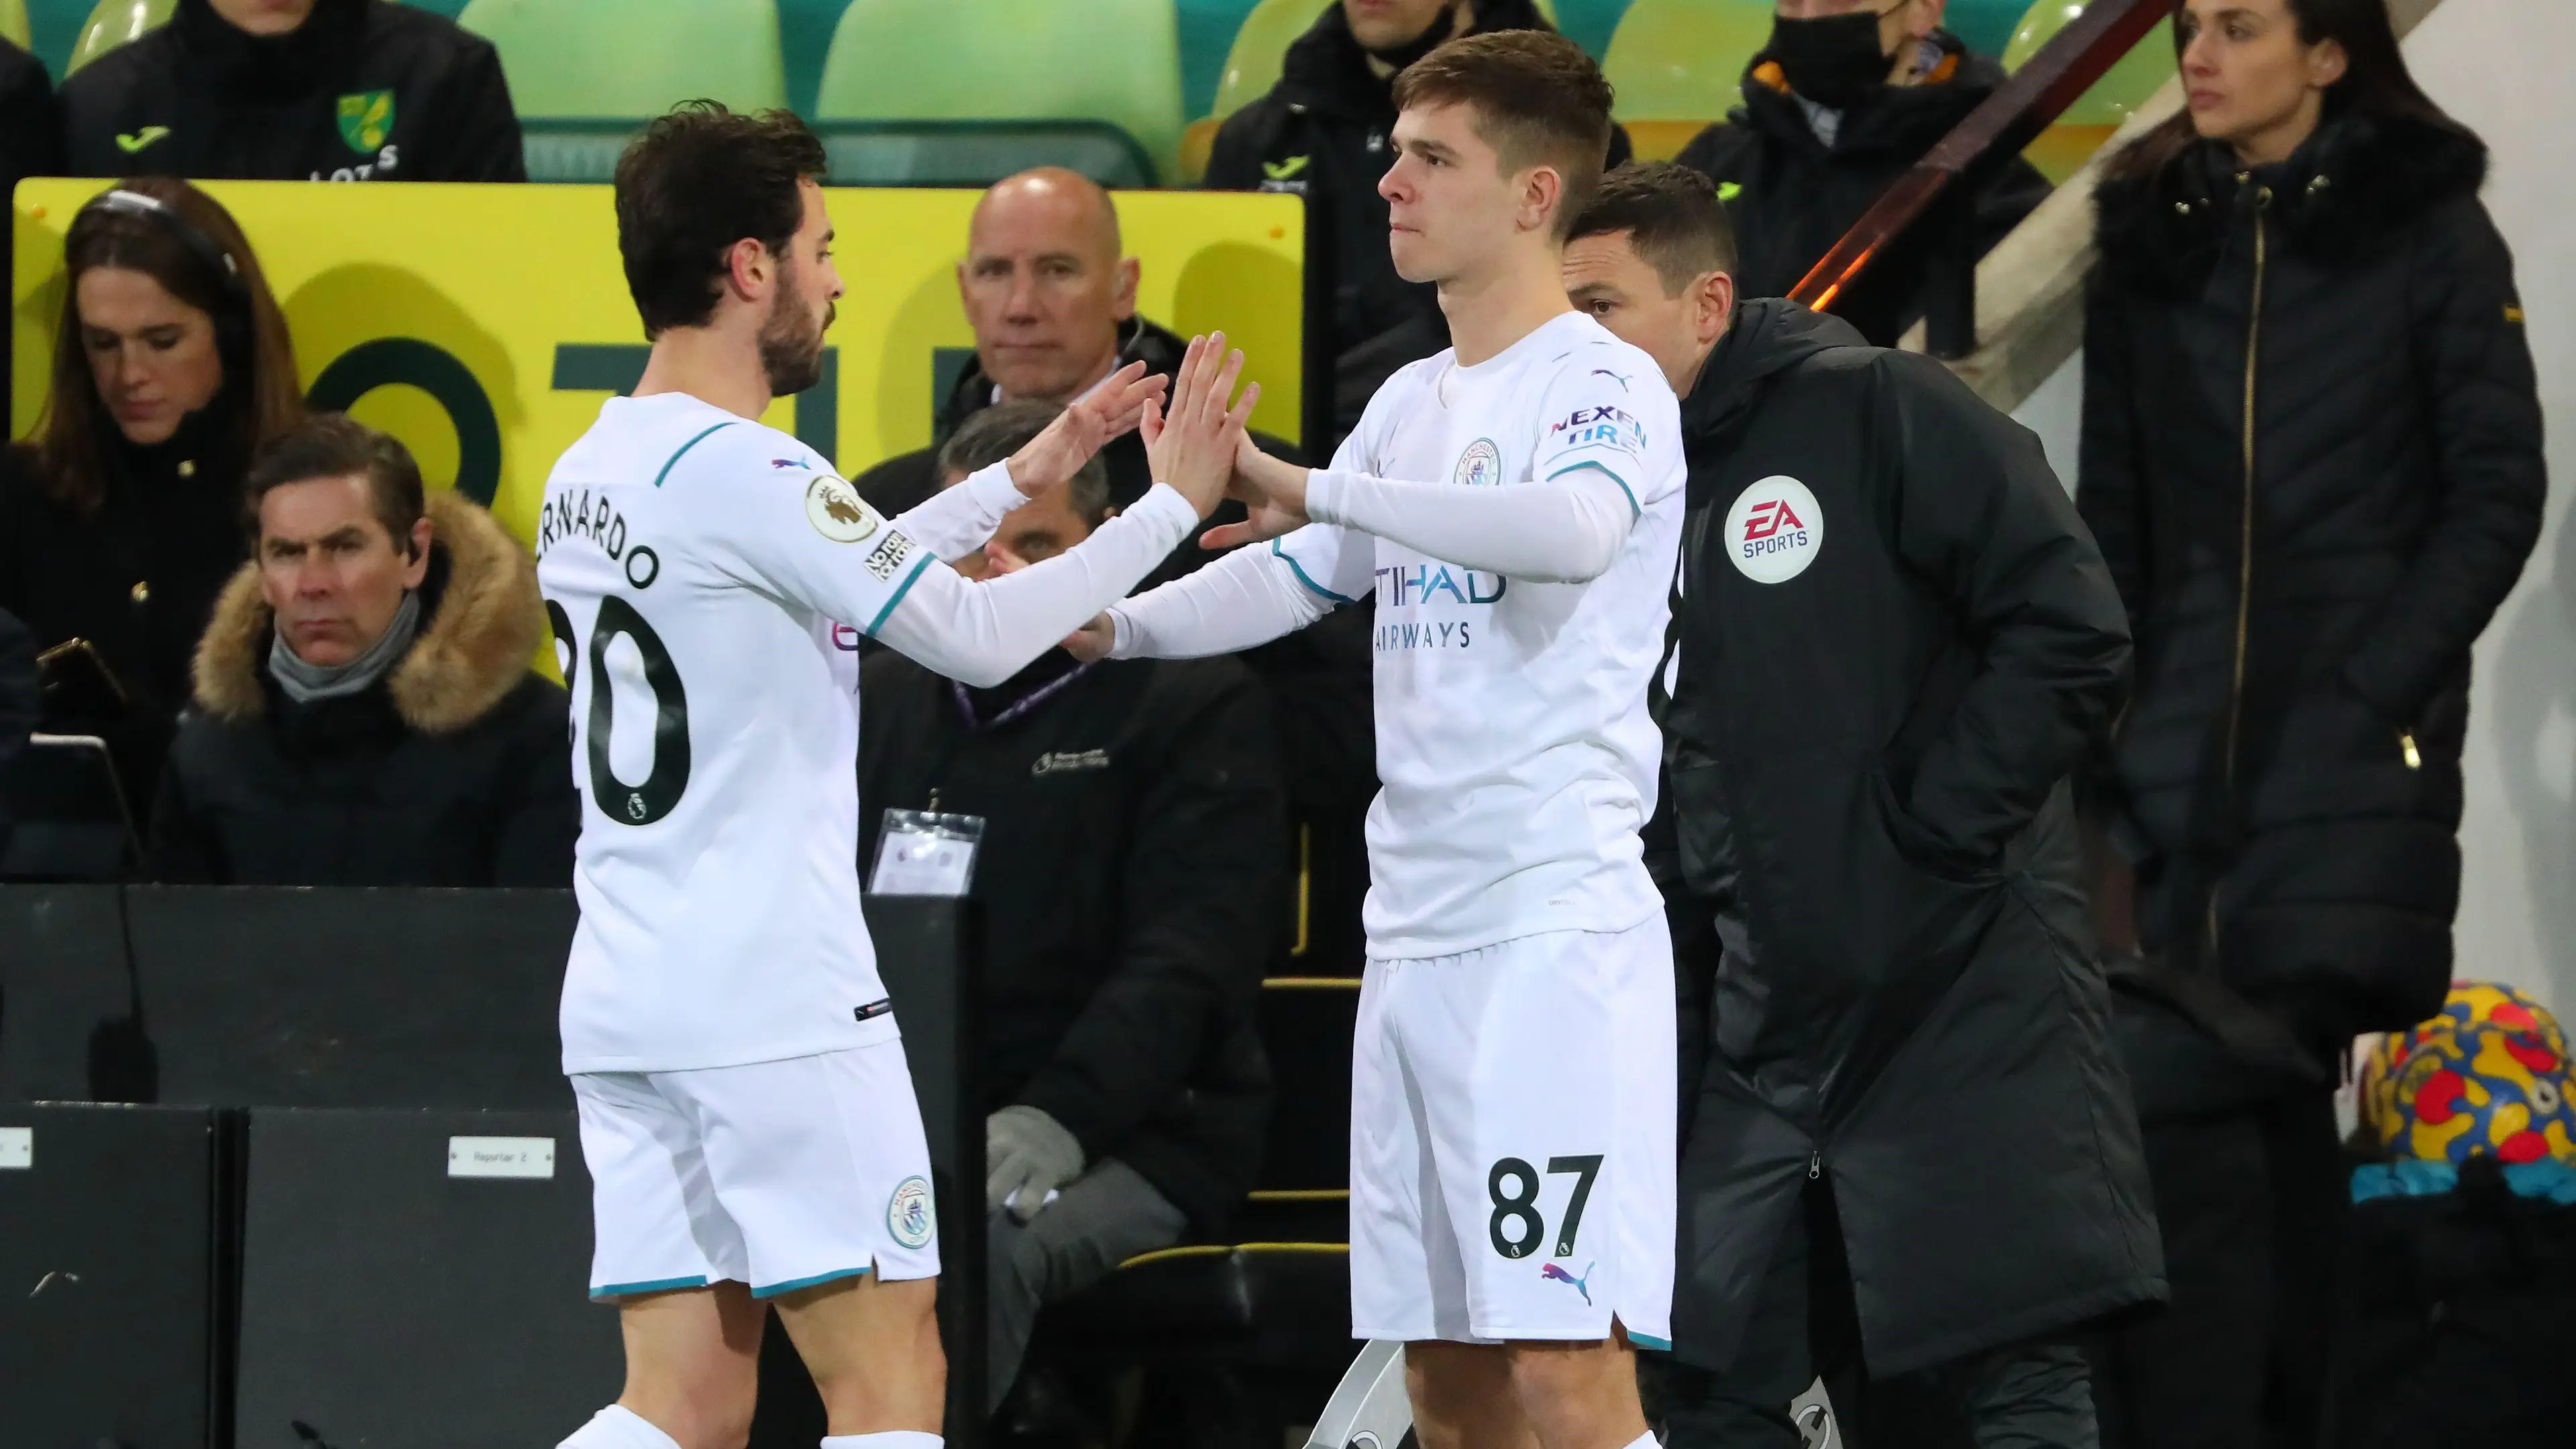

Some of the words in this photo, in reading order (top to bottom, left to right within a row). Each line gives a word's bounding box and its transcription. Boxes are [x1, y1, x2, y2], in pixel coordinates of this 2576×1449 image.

[1549, 405, 1647, 449] NEXEN
[1568, 424, 1638, 454] TIRE
[537, 489, 659, 590] RNARDO
[1744, 498, 1805, 541] EA
[1743, 531, 1808, 559] SPORTS
[1375, 564, 1507, 606] TIHAD
[1375, 621, 1470, 653] AIRWAYS
[520, 1152, 528, 1163] 2
[1488, 1154, 1605, 1259] 87
